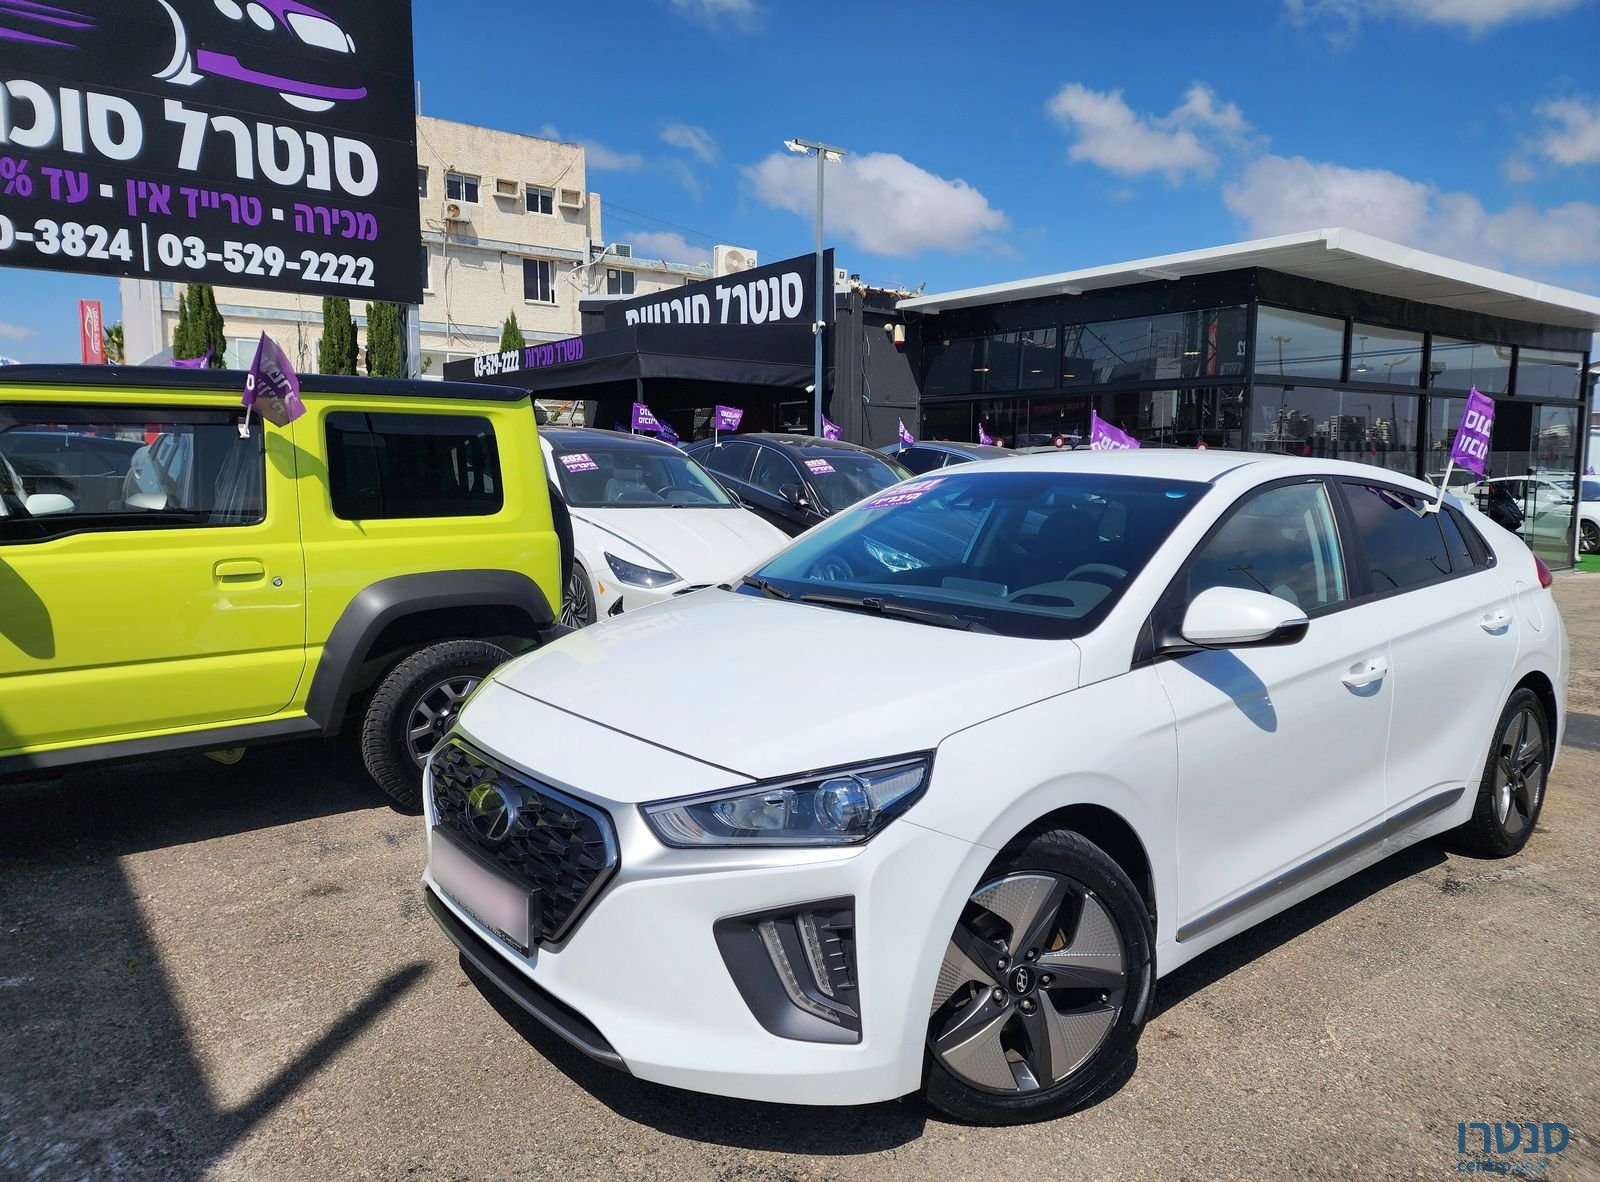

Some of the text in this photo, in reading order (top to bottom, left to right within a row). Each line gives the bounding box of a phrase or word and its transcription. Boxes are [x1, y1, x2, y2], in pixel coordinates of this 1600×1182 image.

[0, 80, 378, 197] סנטרל סוכ
[41, 167, 89, 204] עד
[126, 178, 171, 217] אין
[180, 186, 262, 228] טרייד
[294, 203, 378, 241] מכירה
[157, 233, 375, 288] 03-529-2222
[716, 271, 804, 325] סנטרל
[474, 338, 584, 378] משרד מכירות 03-529-2222
[560, 453, 589, 463] 2021
